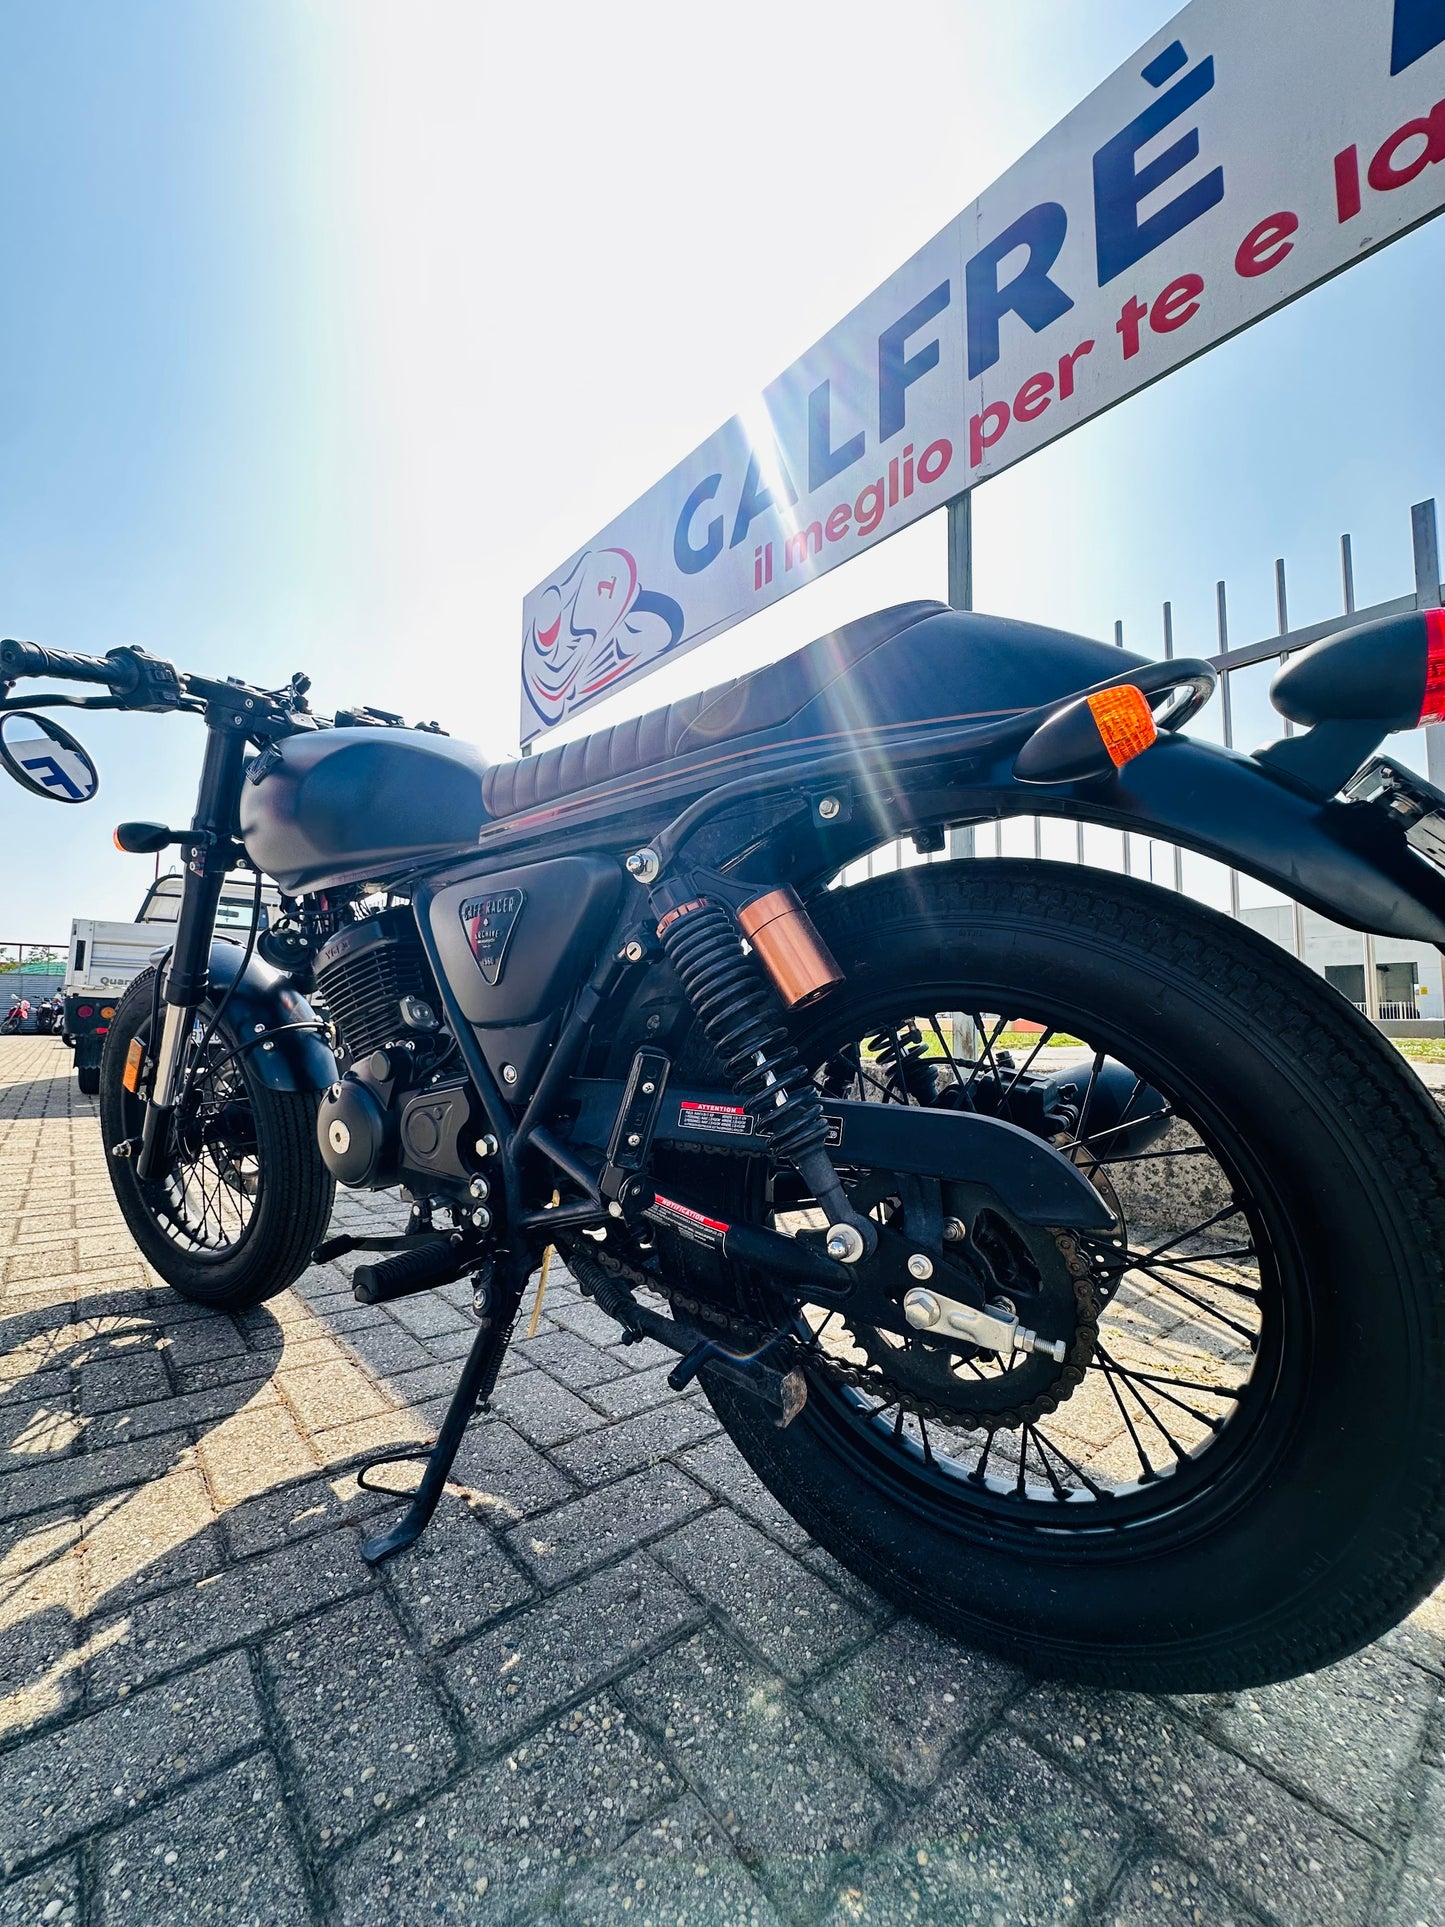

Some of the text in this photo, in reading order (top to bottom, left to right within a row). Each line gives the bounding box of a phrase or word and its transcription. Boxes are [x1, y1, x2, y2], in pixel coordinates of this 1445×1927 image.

[673, 39, 1225, 575] GALFRÉ
[753, 542, 774, 592] il
[784, 438, 953, 573] meglio
[969, 339, 1096, 468] per
[1115, 273, 1205, 361] te
[1234, 210, 1300, 278] e
[463, 897, 515, 921] CAFE RACER
[475, 929, 500, 940] ARCHIVE
[100, 976, 131, 987] Quar
[697, 1103, 737, 1114] ATTENTION
[661, 1199, 705, 1223] NOTIFICATION
